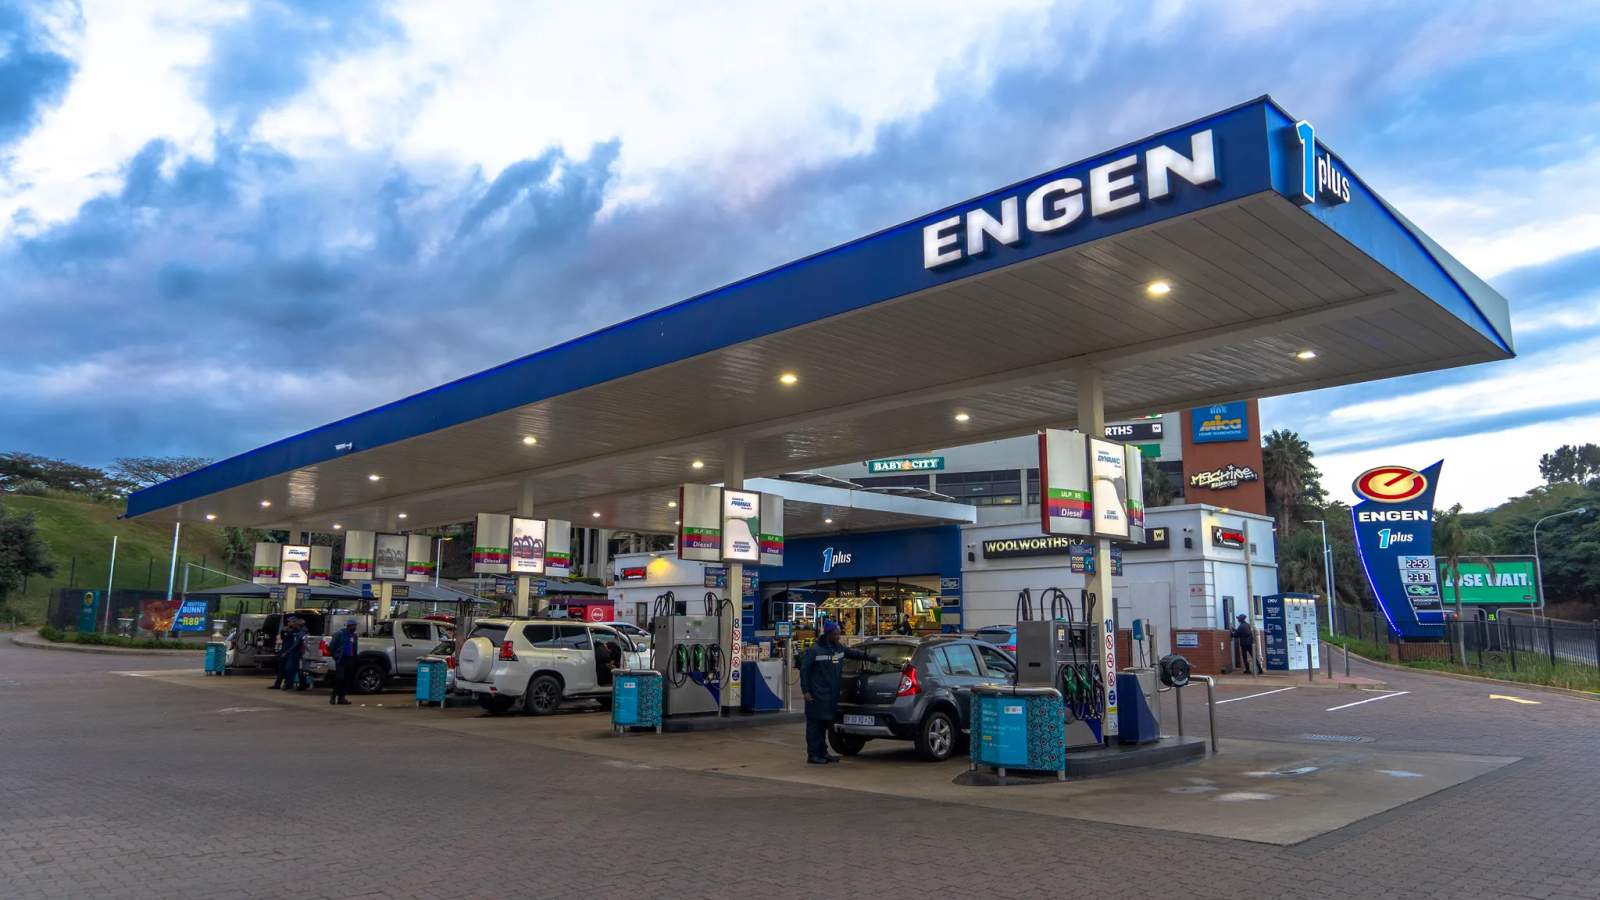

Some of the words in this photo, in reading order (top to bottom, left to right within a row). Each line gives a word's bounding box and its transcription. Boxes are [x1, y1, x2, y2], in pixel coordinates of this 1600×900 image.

[923, 128, 1218, 269] ENGEN
[1105, 426, 1134, 438] RTHS
[873, 462, 903, 474] BABY
[911, 458, 940, 471] CITY
[1061, 508, 1083, 518] Diesel
[1358, 510, 1428, 523] ENGEN
[692, 541, 713, 549] Diesel
[984, 537, 1069, 554] WOOLWORTHS
[734, 618, 740, 629] 8
[1104, 619, 1113, 633] 10
